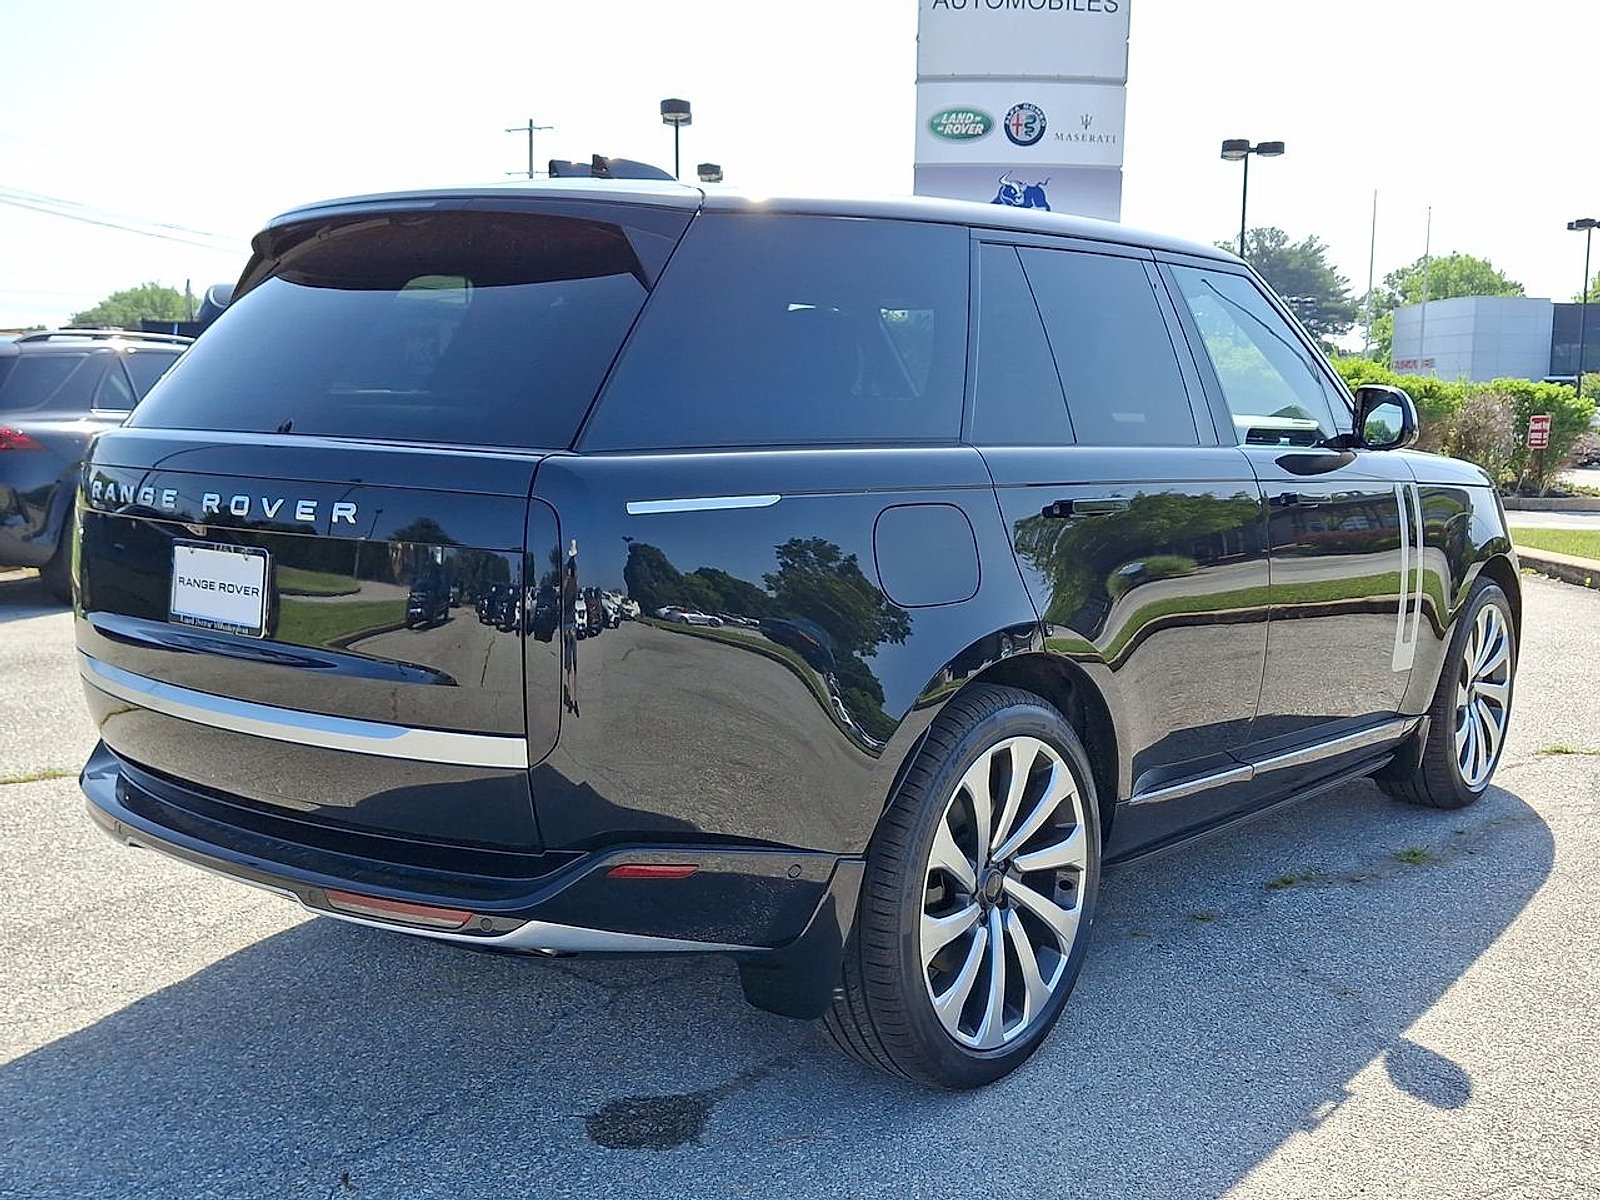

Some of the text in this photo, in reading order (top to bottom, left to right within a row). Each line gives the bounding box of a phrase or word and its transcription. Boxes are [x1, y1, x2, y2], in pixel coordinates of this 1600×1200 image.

[941, 112, 974, 123] LAND
[943, 123, 984, 134] ROVER
[1053, 132, 1118, 144] MASERATI
[92, 480, 358, 524] RANGE ROVER
[178, 576, 260, 597] RANGE ROVER
